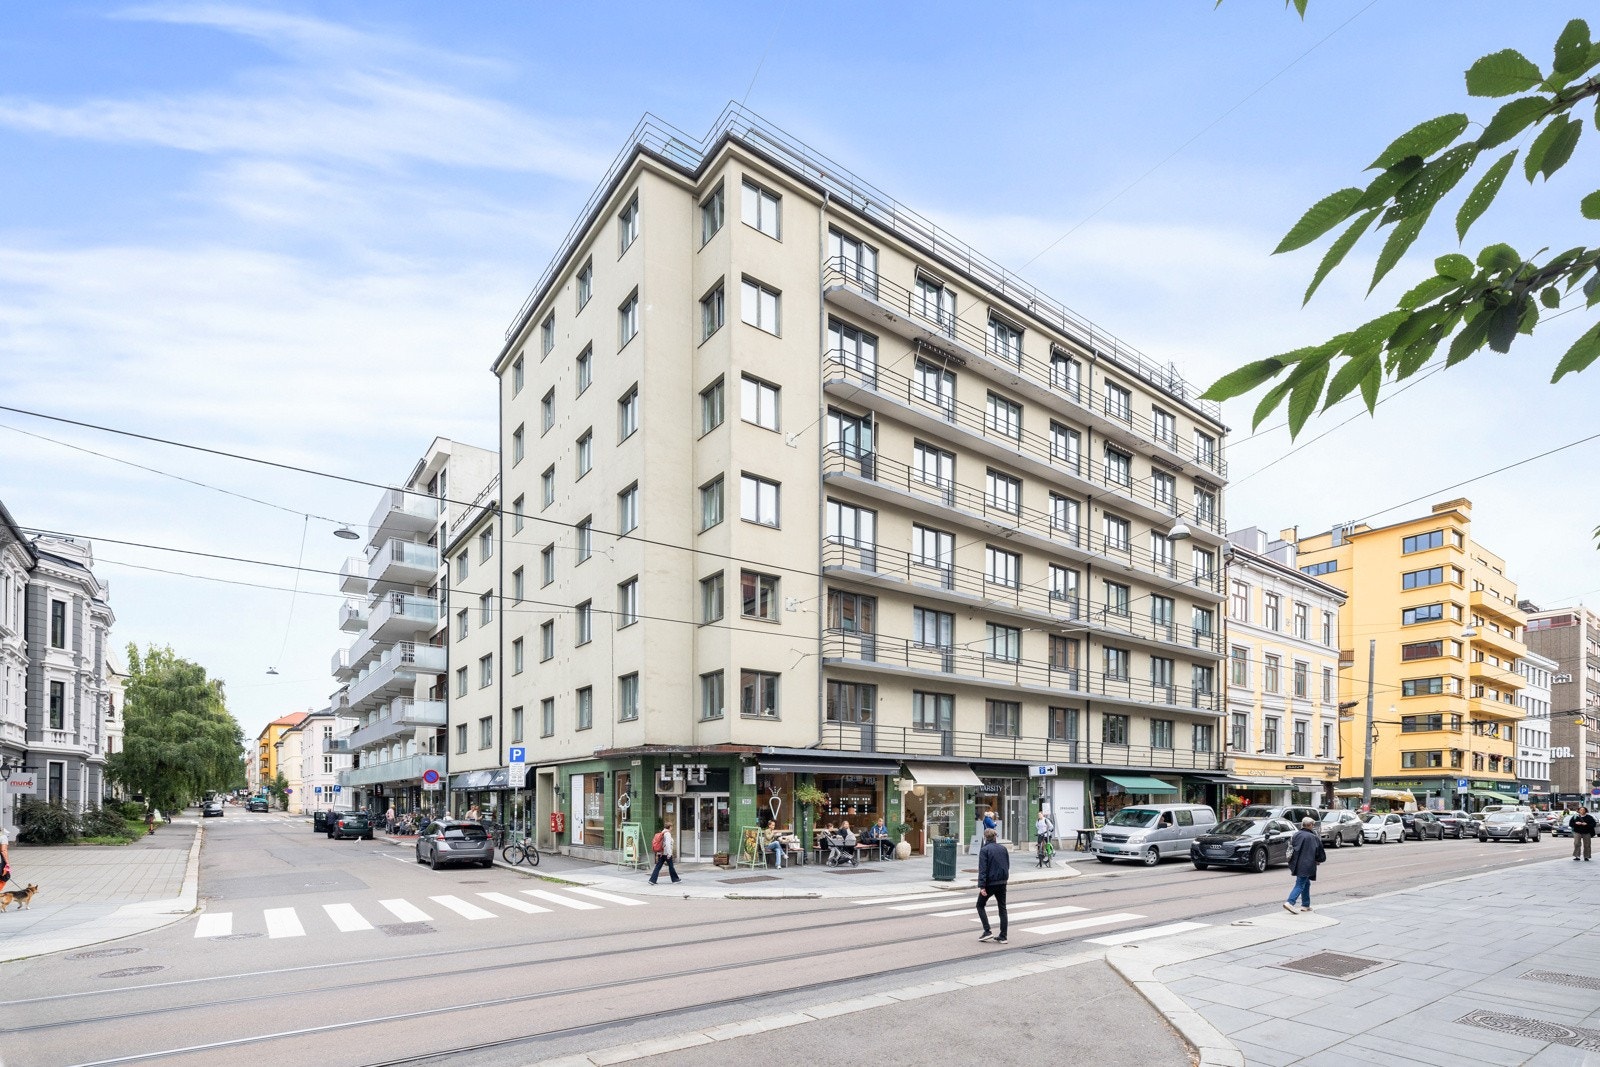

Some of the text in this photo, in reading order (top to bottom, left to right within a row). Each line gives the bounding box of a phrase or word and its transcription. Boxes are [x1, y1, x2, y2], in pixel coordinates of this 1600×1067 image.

[513, 749, 521, 760] P
[661, 764, 708, 781] LETT
[828, 797, 871, 815] LETT
